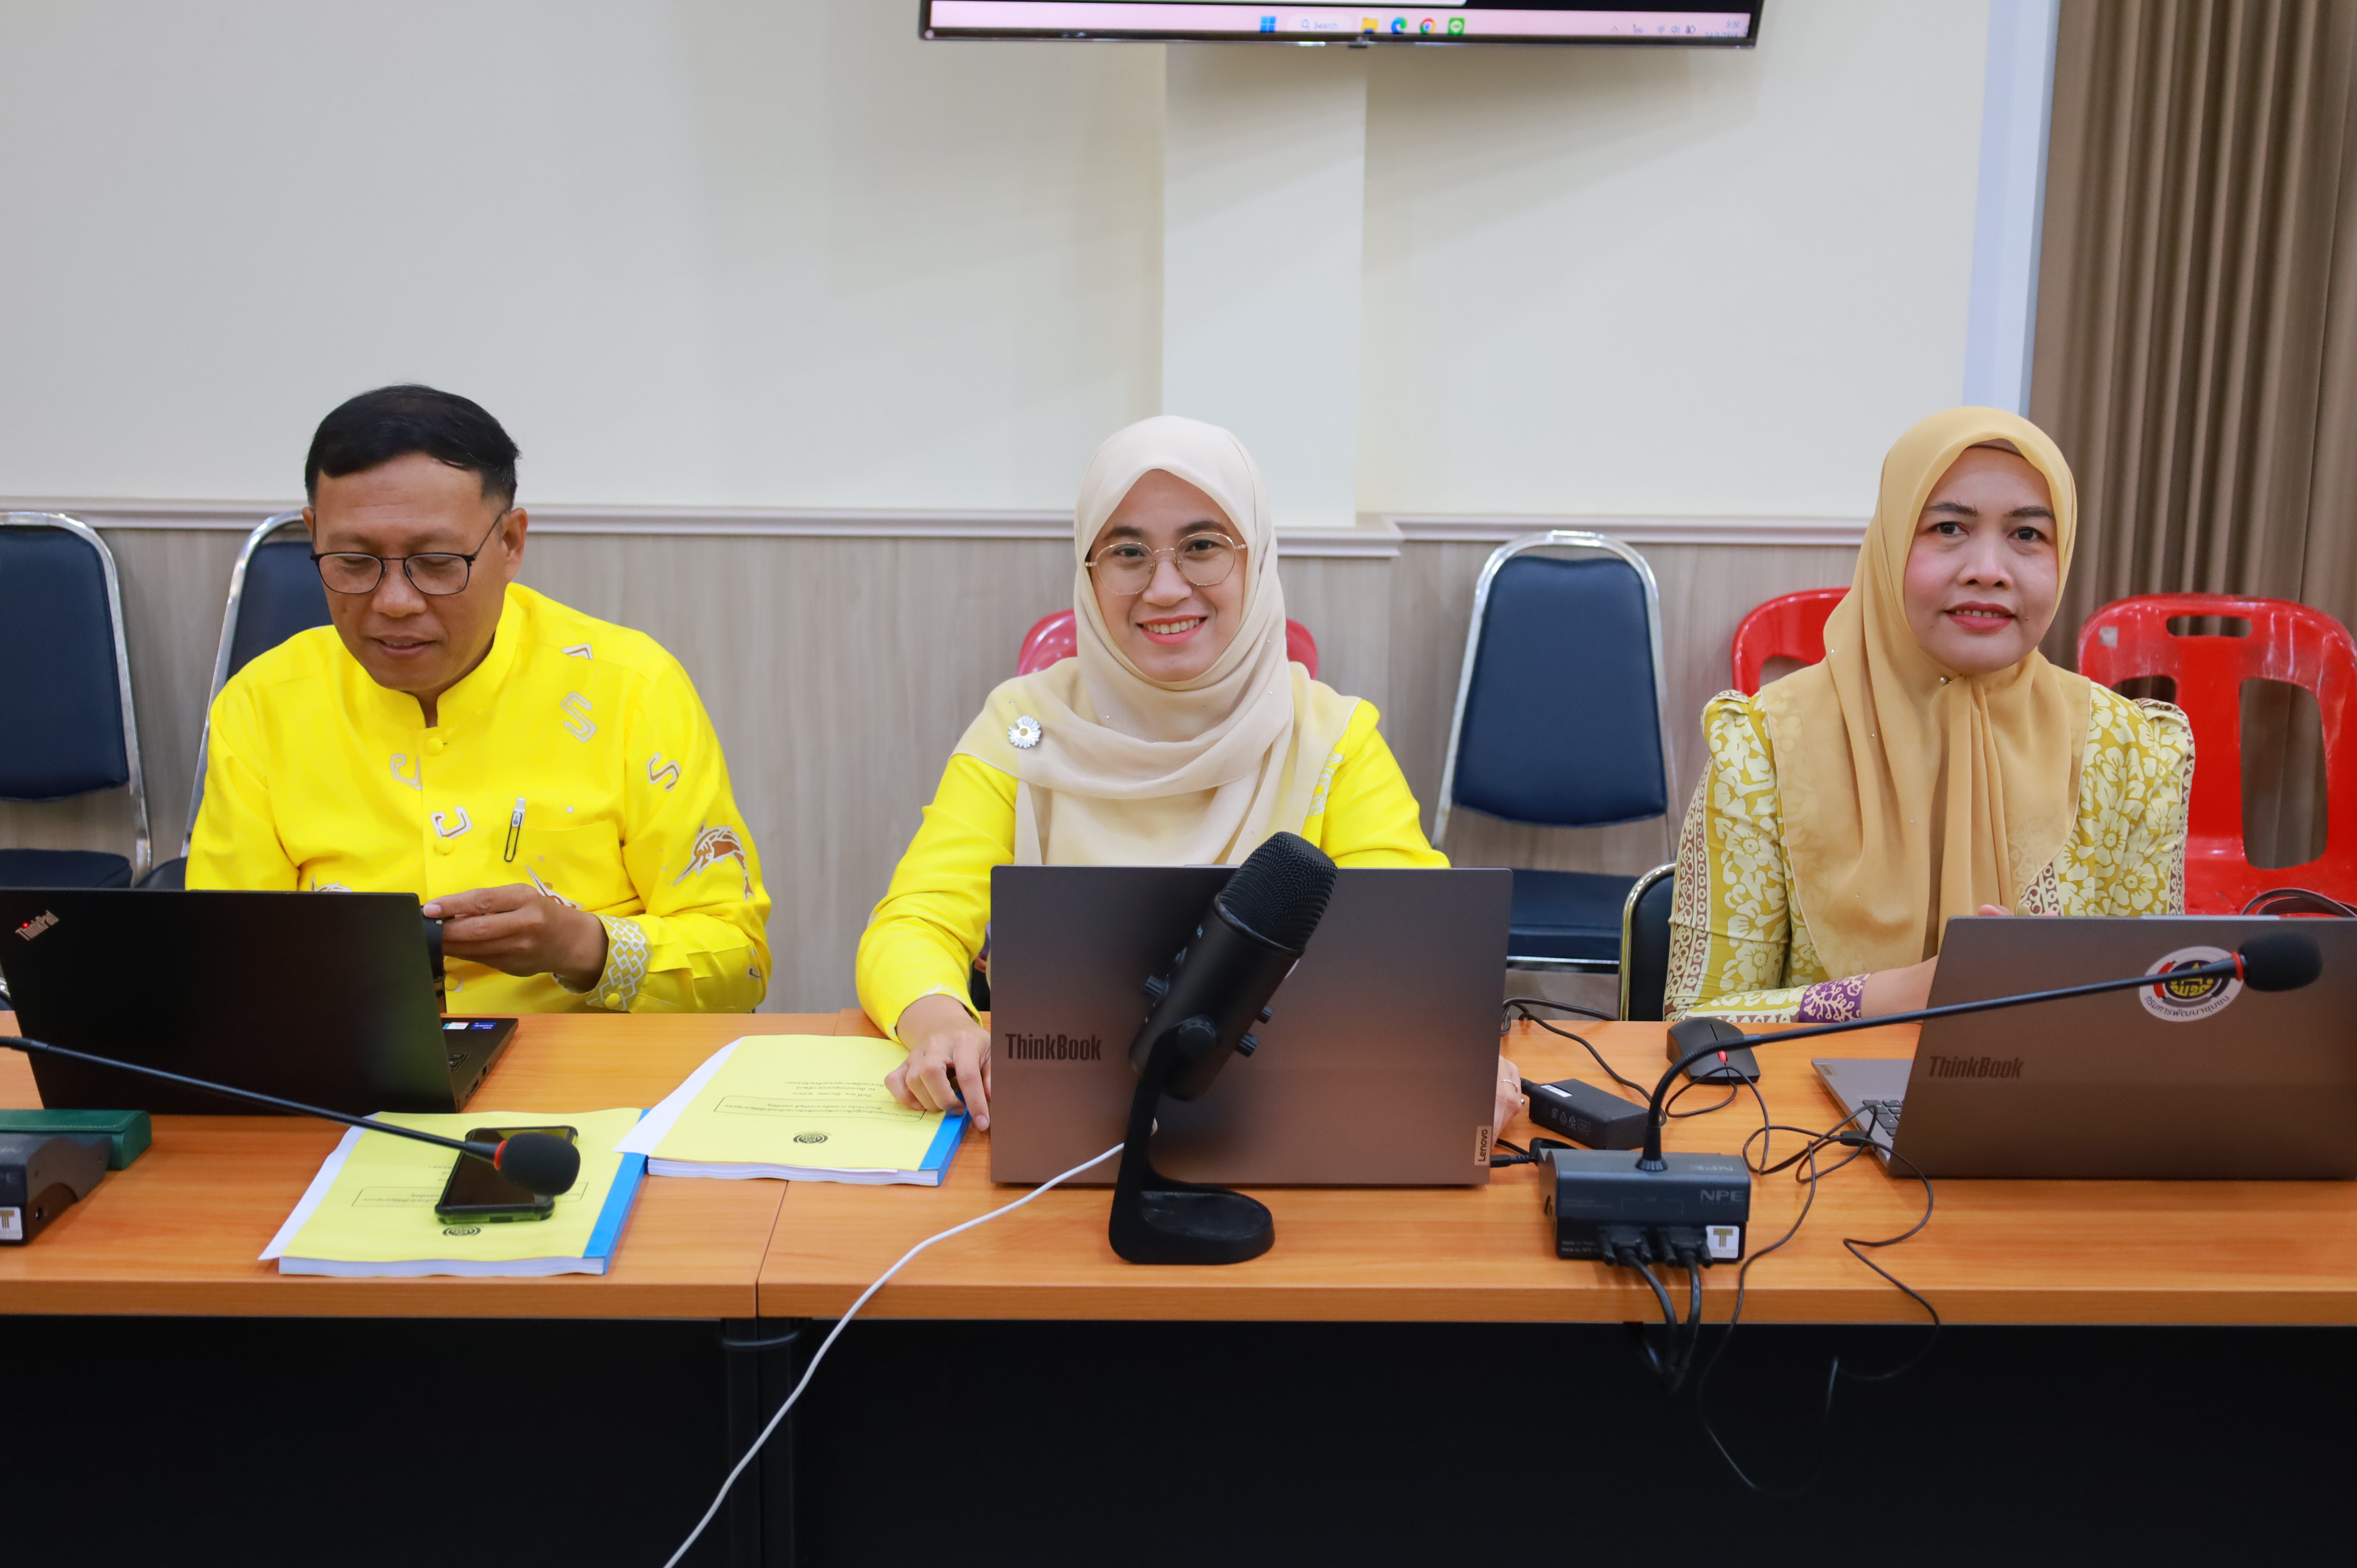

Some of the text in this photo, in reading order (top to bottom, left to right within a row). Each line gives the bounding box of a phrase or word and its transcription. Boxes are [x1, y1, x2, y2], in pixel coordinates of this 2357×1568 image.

[1314, 21, 1338, 29] Search
[15, 909, 59, 941] ThinkPad
[2144, 995, 2231, 1017] กรมการพัฒนาชุมชน
[1005, 1033, 1102, 1060] ThinkBook
[1929, 1055, 2024, 1079] ThinkBook
[1477, 1128, 1488, 1162] Lenovo
[1700, 1189, 1745, 1202] NPE
[1713, 1228, 1734, 1248] T
